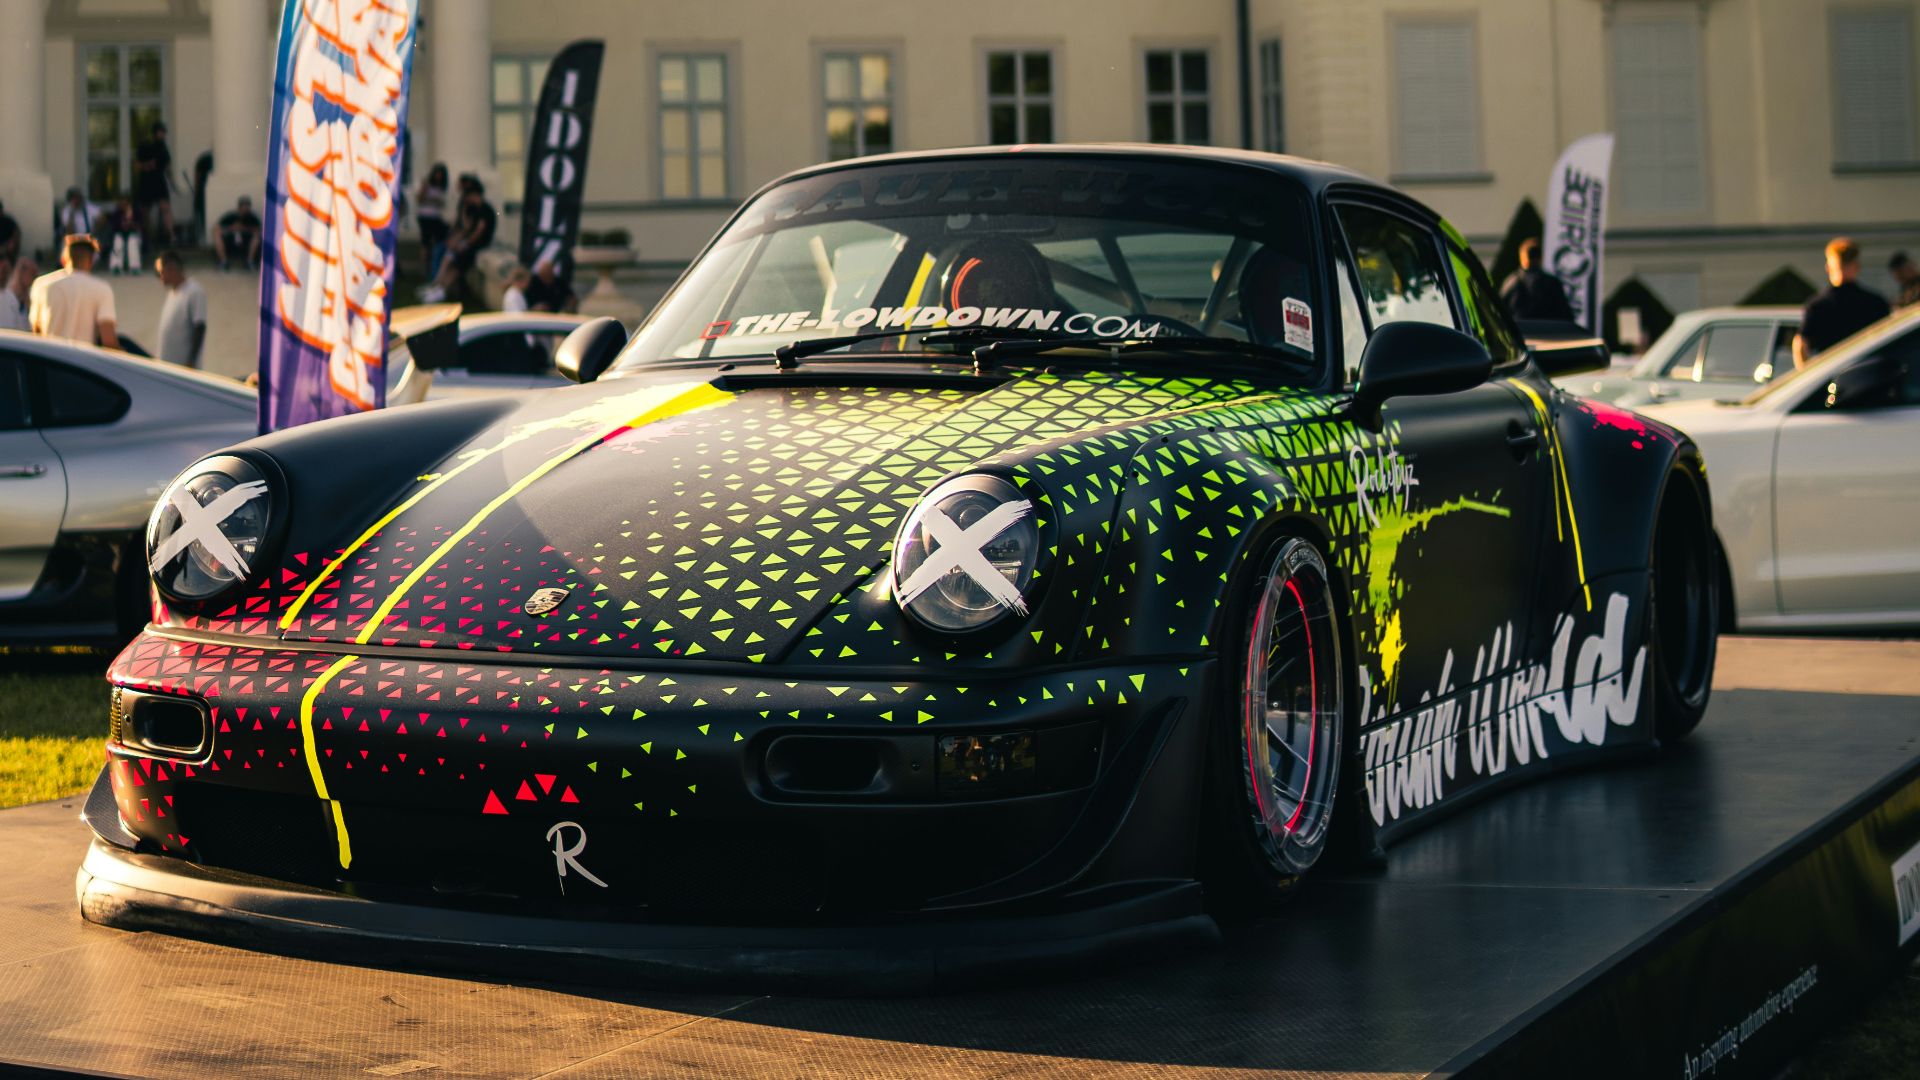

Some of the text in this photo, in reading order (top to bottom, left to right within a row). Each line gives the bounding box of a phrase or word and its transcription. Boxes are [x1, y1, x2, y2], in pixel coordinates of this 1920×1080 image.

[731, 306, 1161, 339] THE-LOWDOWN.COM
[1468, 591, 1647, 777] World
[545, 820, 609, 896] R
